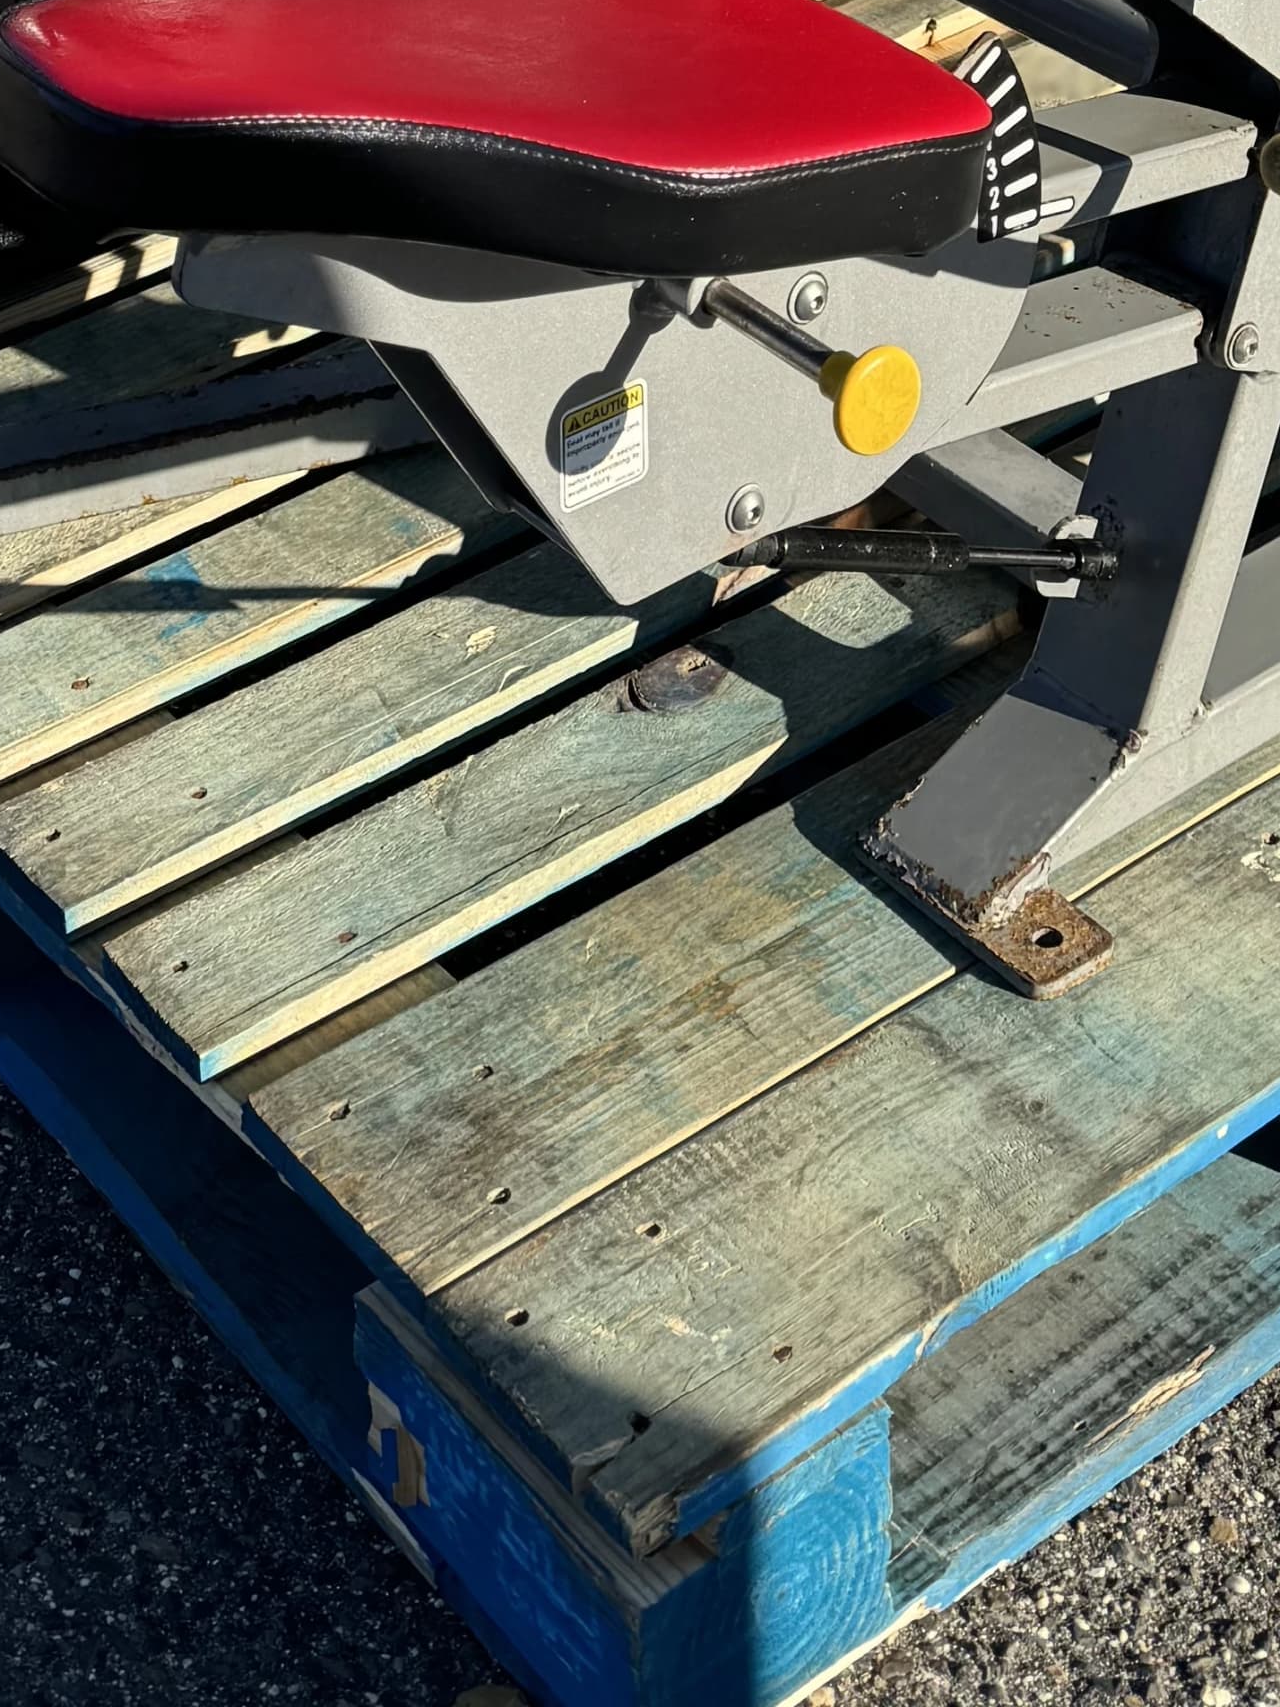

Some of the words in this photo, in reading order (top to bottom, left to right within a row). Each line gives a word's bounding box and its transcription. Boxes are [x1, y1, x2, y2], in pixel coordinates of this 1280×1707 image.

[987, 157, 998, 181] 3
[989, 186, 1000, 210] 2
[991, 215, 998, 237] 1
[583, 391, 639, 424] CAUTION
